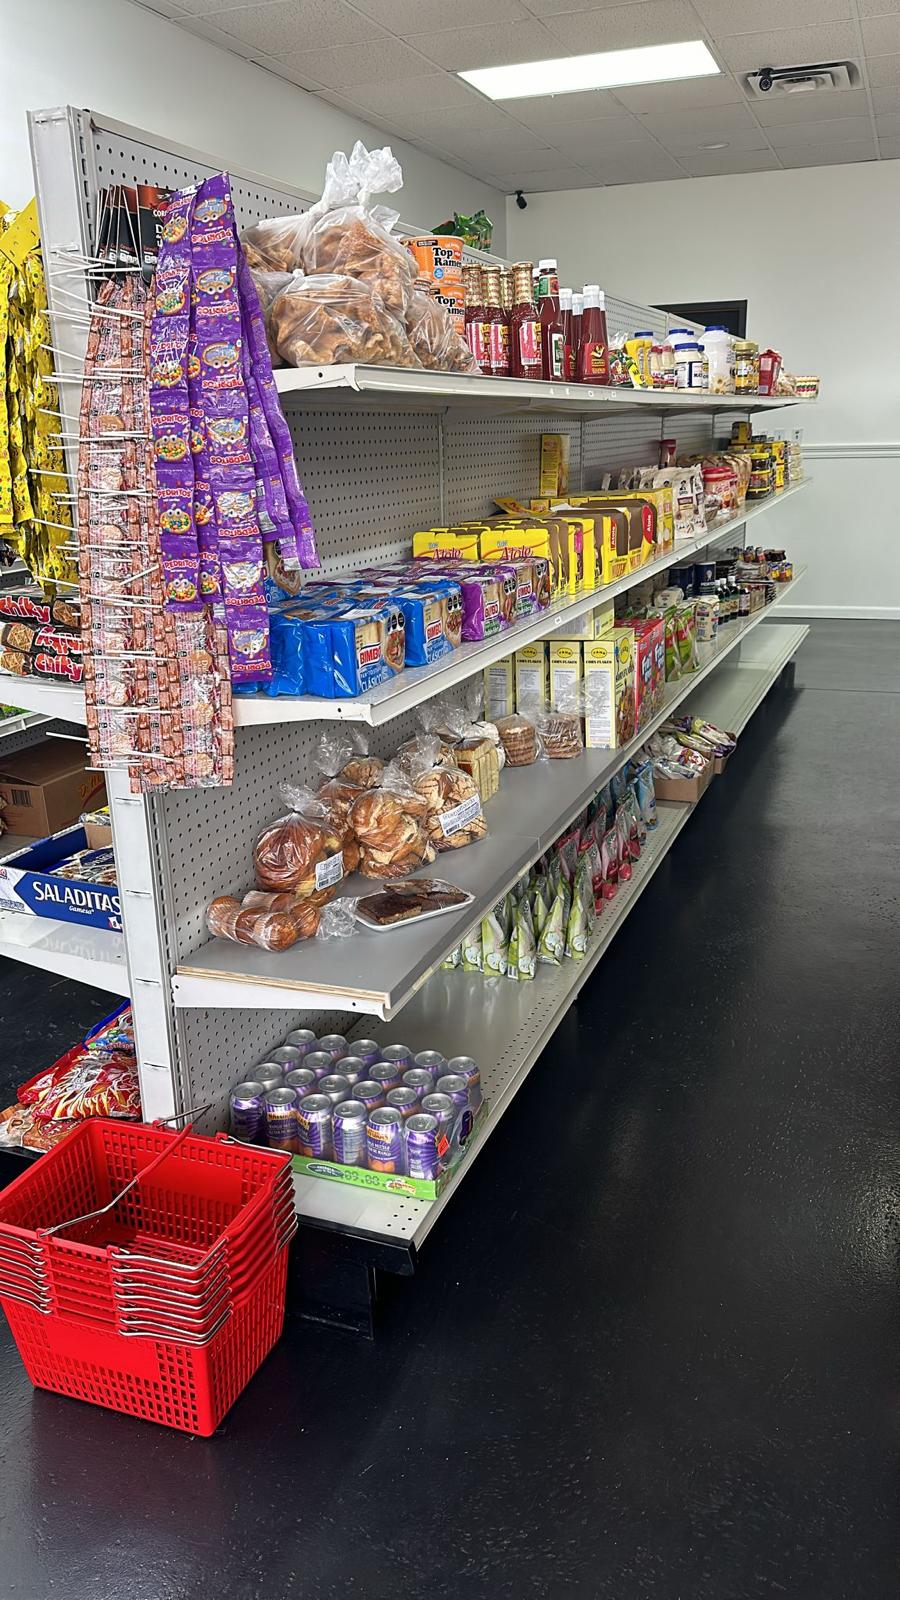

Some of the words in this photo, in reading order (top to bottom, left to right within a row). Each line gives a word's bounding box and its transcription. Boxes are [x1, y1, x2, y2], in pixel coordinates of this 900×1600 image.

[433, 247, 453, 259] Top
[434, 257, 462, 267] Rame
[435, 295, 456, 307] Top
[210, 453, 251, 465] PEDRITOS
[157, 488, 192, 498] PEDRITOS
[218, 525, 260, 537] PEDRITOS
[502, 545, 533, 560] Atole
[163, 559, 198, 570] PEDRITOS
[225, 595, 266, 606] PEDRITOS
[35, 625, 83, 655] hiky
[35, 653, 83, 683] Chiky
[232, 661, 272, 672] PEDRITOS
[32, 880, 122, 915] SALADITAS
